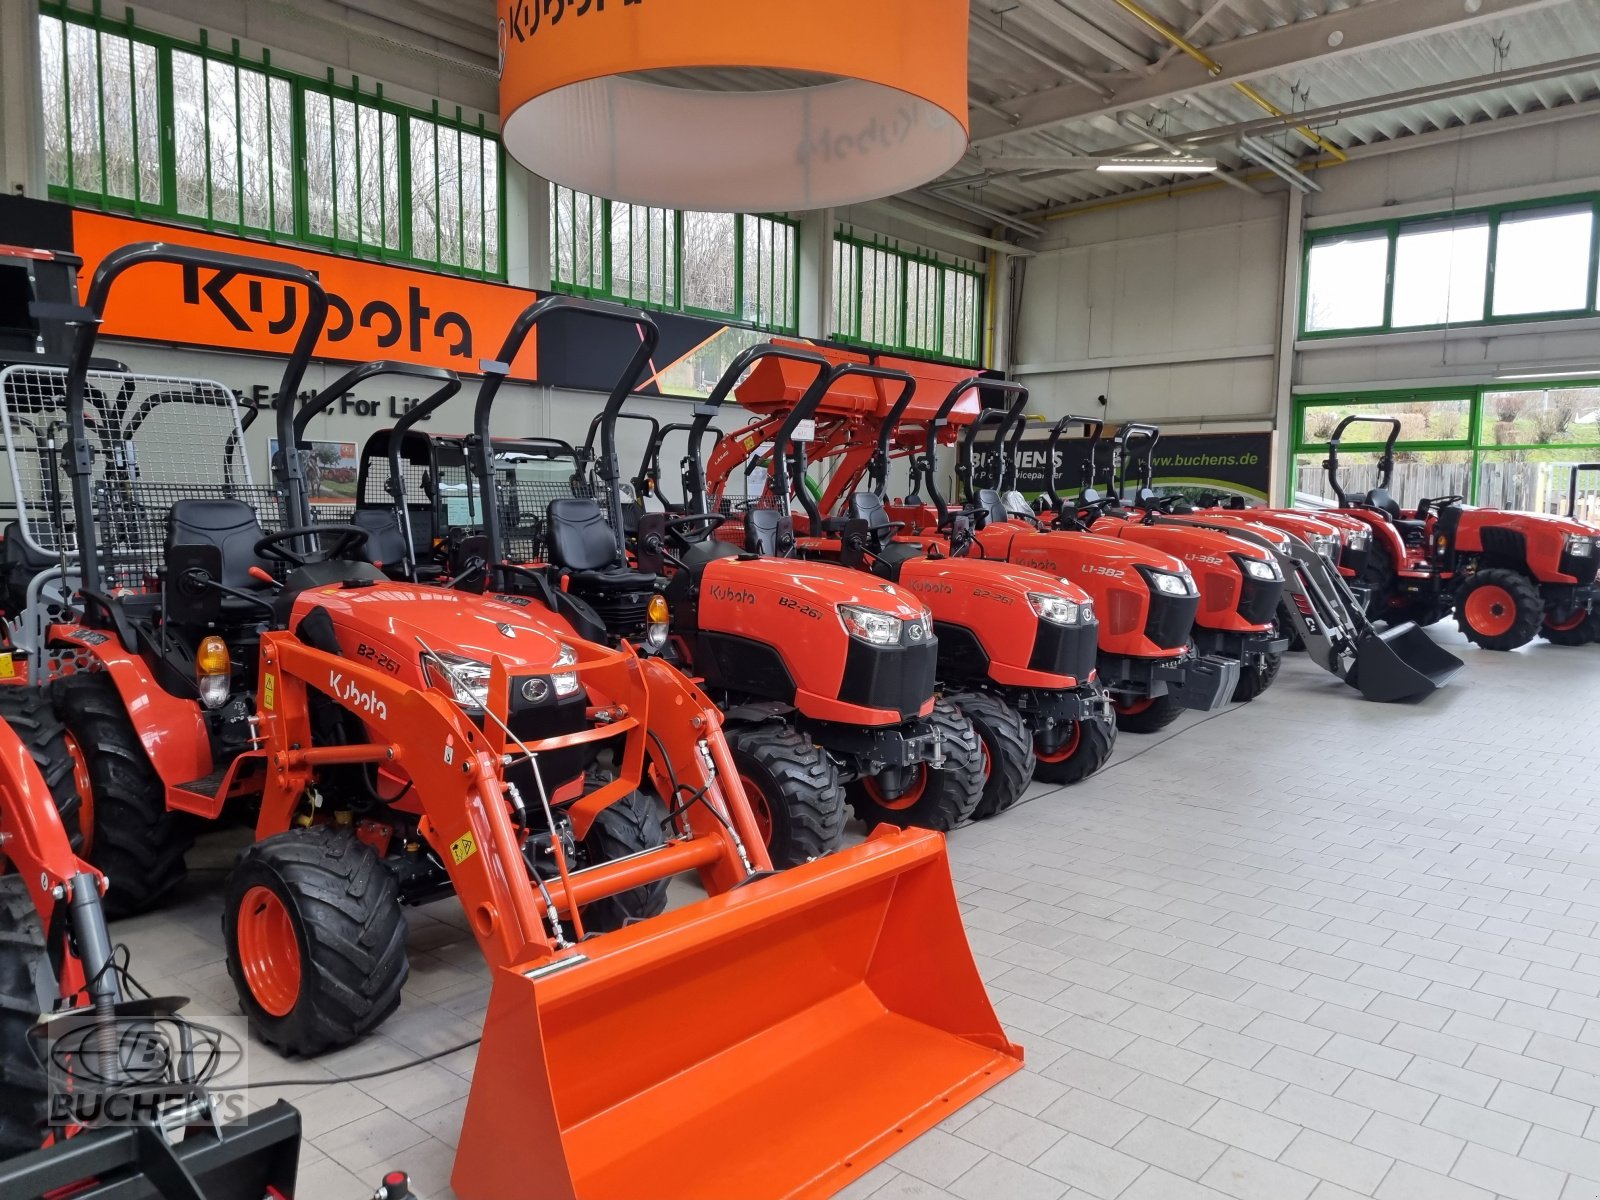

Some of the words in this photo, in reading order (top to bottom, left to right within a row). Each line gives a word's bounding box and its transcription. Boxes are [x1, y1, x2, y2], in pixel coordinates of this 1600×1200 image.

[341, 392, 381, 417] For
[1184, 553, 1224, 566] L1-382
[1081, 564, 1125, 579] L1-382
[709, 584, 756, 605] Kubota
[908, 580, 953, 595] Kubota
[778, 596, 824, 620] B2-261
[357, 643, 401, 675] B2-261
[329, 670, 387, 721] Kubota
